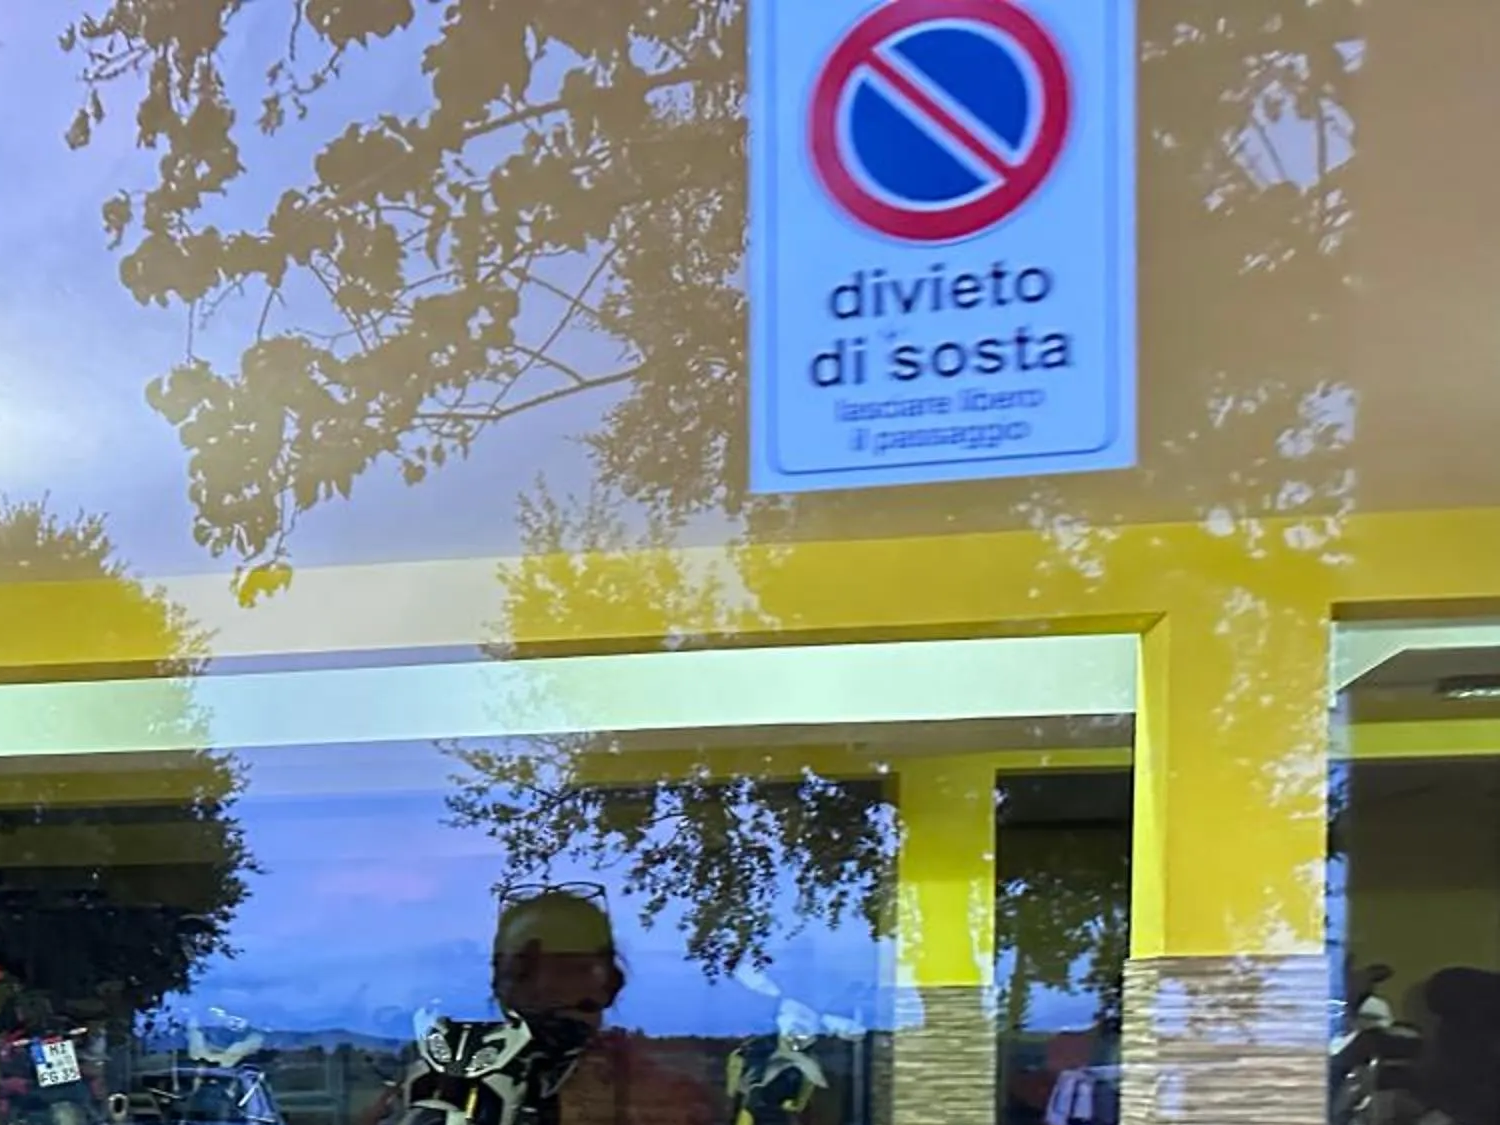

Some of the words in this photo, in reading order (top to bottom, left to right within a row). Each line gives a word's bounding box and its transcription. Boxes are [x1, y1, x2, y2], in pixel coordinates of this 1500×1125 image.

[829, 261, 1053, 319] divieto
[810, 336, 866, 387] di
[889, 327, 1073, 381] sosta
